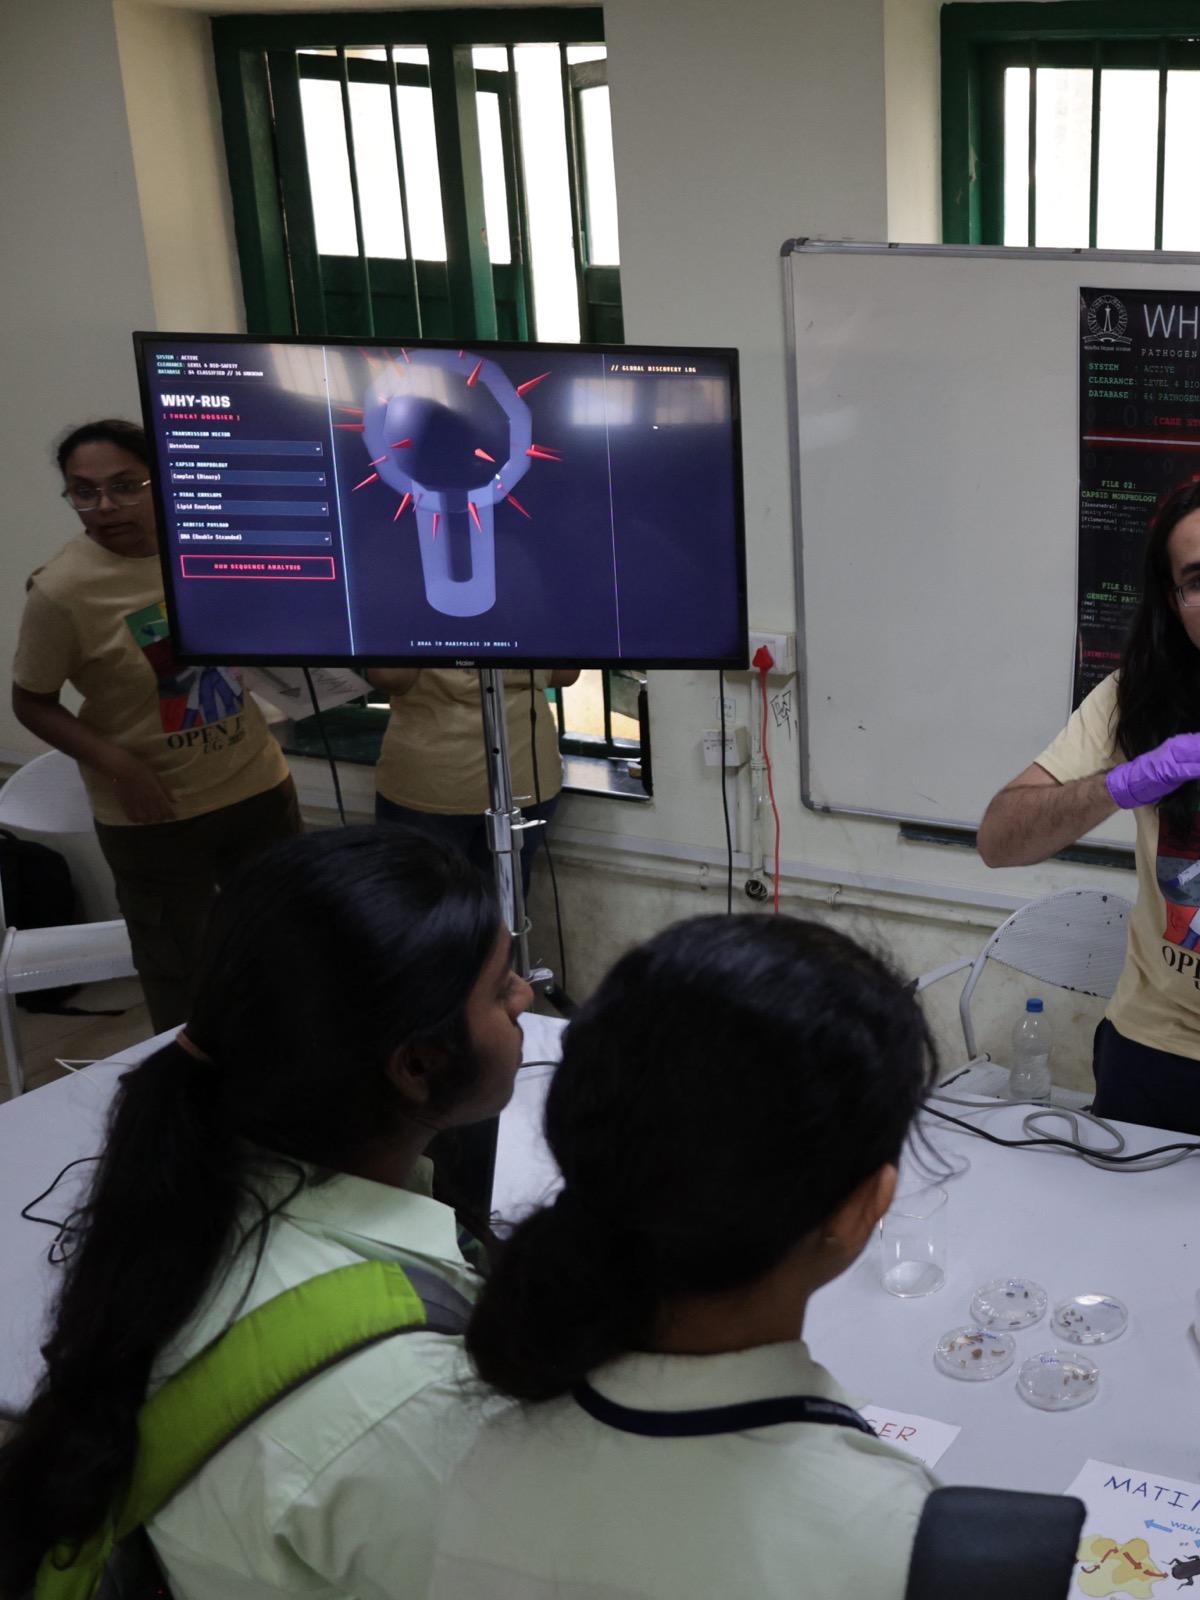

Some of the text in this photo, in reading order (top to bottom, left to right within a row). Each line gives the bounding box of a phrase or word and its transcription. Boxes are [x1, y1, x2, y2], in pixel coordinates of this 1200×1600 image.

[1141, 349, 1197, 358] PATHOGEN
[1089, 363, 1119, 371] SYSTEM
[161, 395, 230, 408] WHY-RUS
[1102, 480, 1119, 488] FILE
[1082, 491, 1108, 499] CAPSID
[1102, 582, 1120, 590] FILE
[864, 1418, 917, 1441] ER
